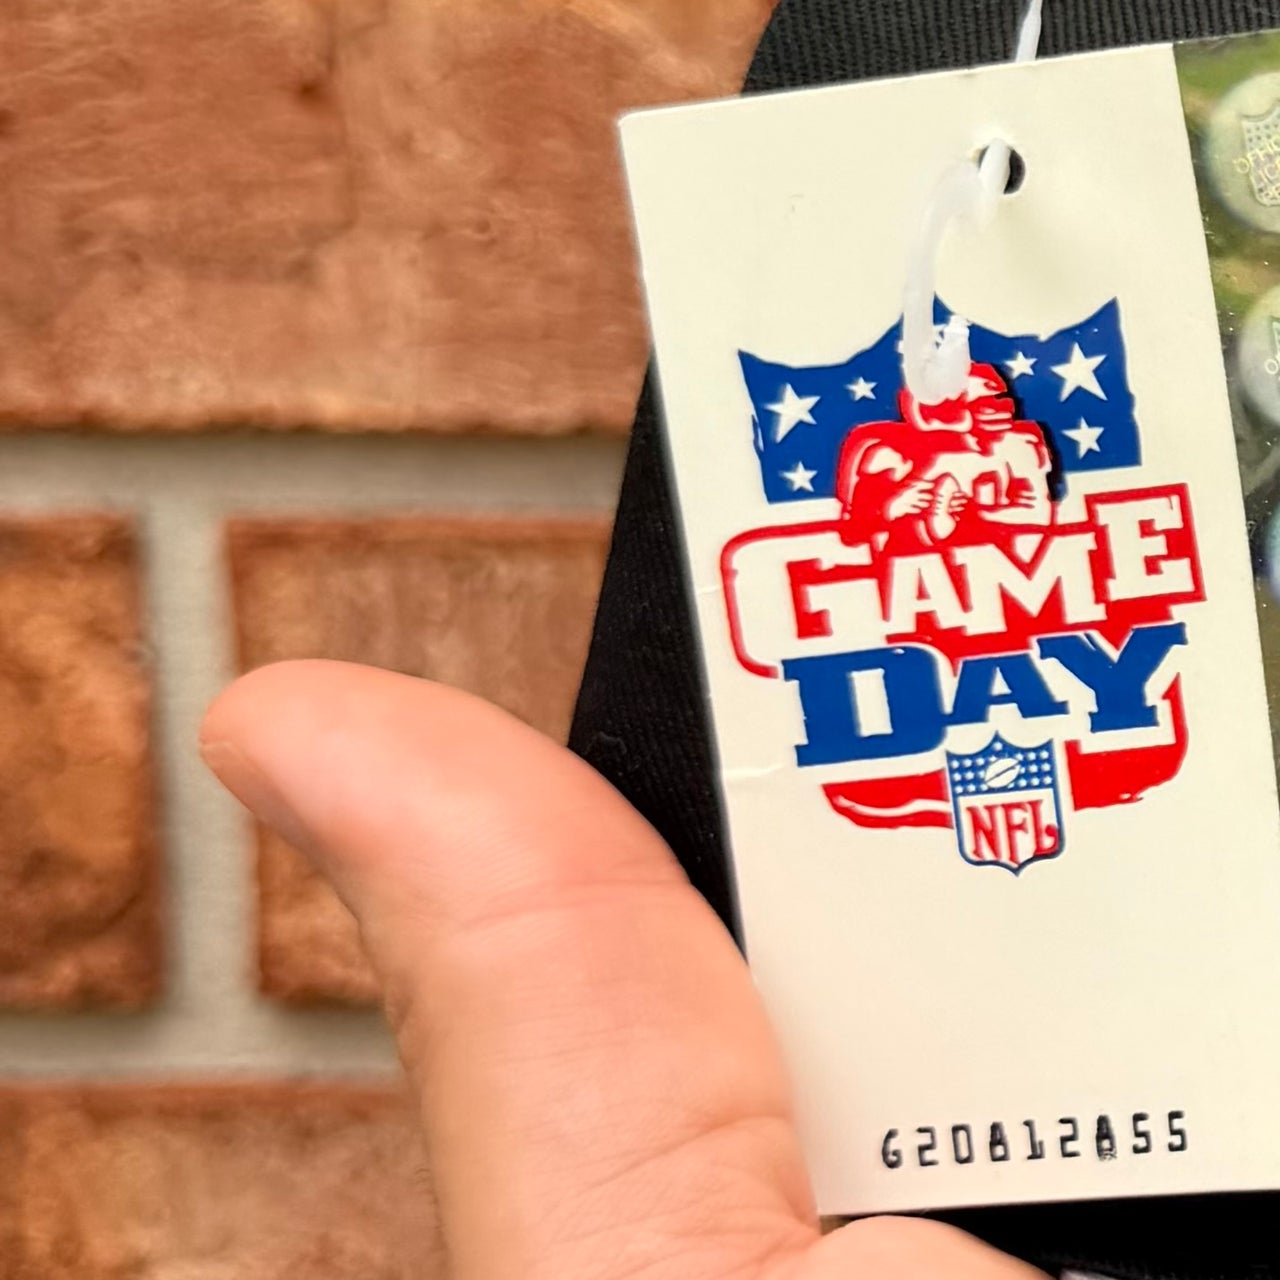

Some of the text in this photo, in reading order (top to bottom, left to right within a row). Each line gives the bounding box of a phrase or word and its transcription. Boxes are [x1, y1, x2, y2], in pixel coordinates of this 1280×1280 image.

[722, 485, 1206, 658] GAME
[783, 622, 1188, 767] DAY
[966, 799, 1060, 864] NFL
